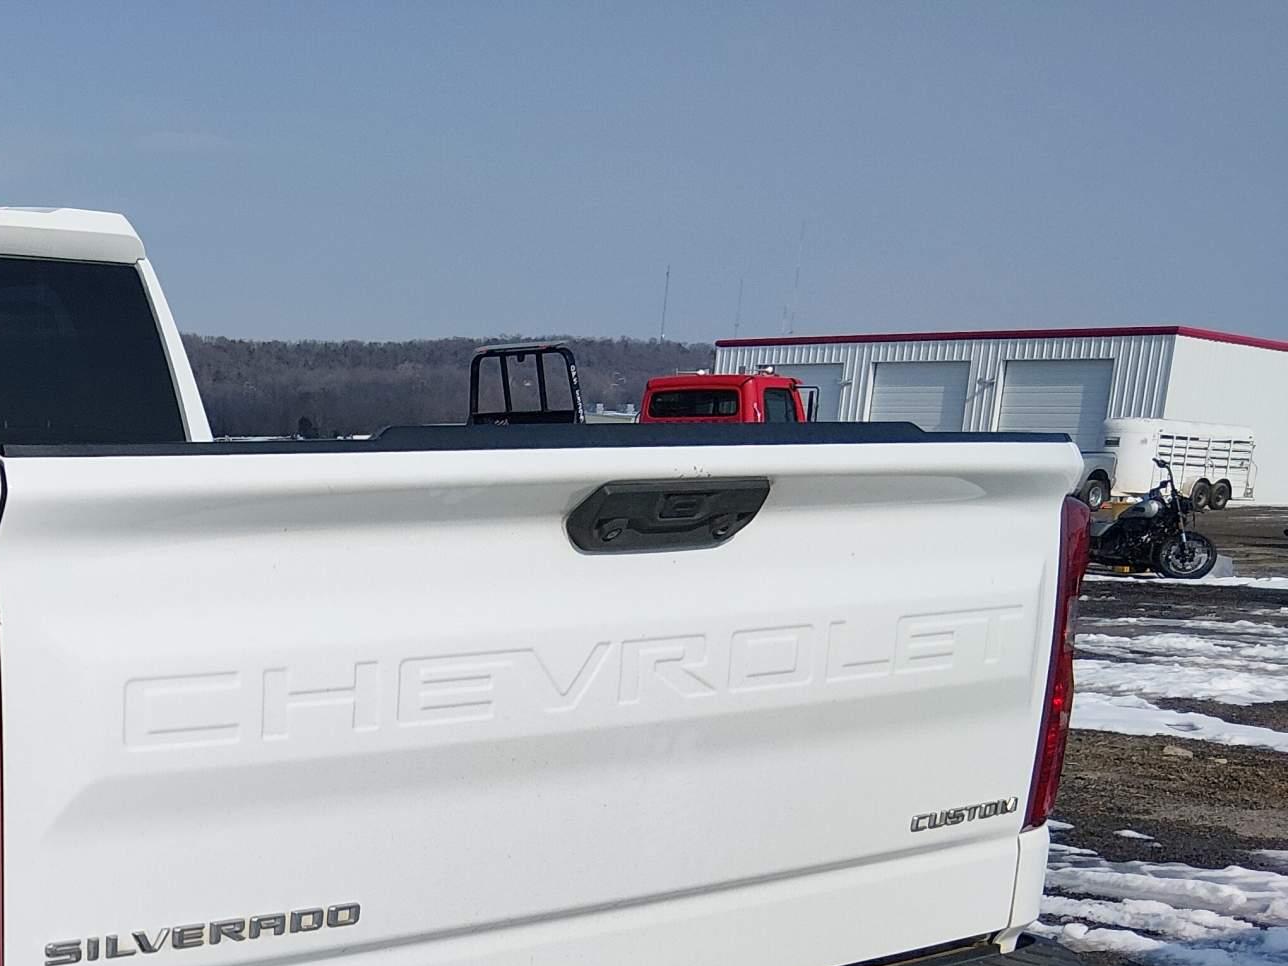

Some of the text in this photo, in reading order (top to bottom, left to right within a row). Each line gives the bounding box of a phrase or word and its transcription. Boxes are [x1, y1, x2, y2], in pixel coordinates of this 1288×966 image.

[123, 604, 1024, 752] CHEVROLET
[910, 796, 1018, 832] CUSTOM
[44, 902, 360, 966] SILVERADO
